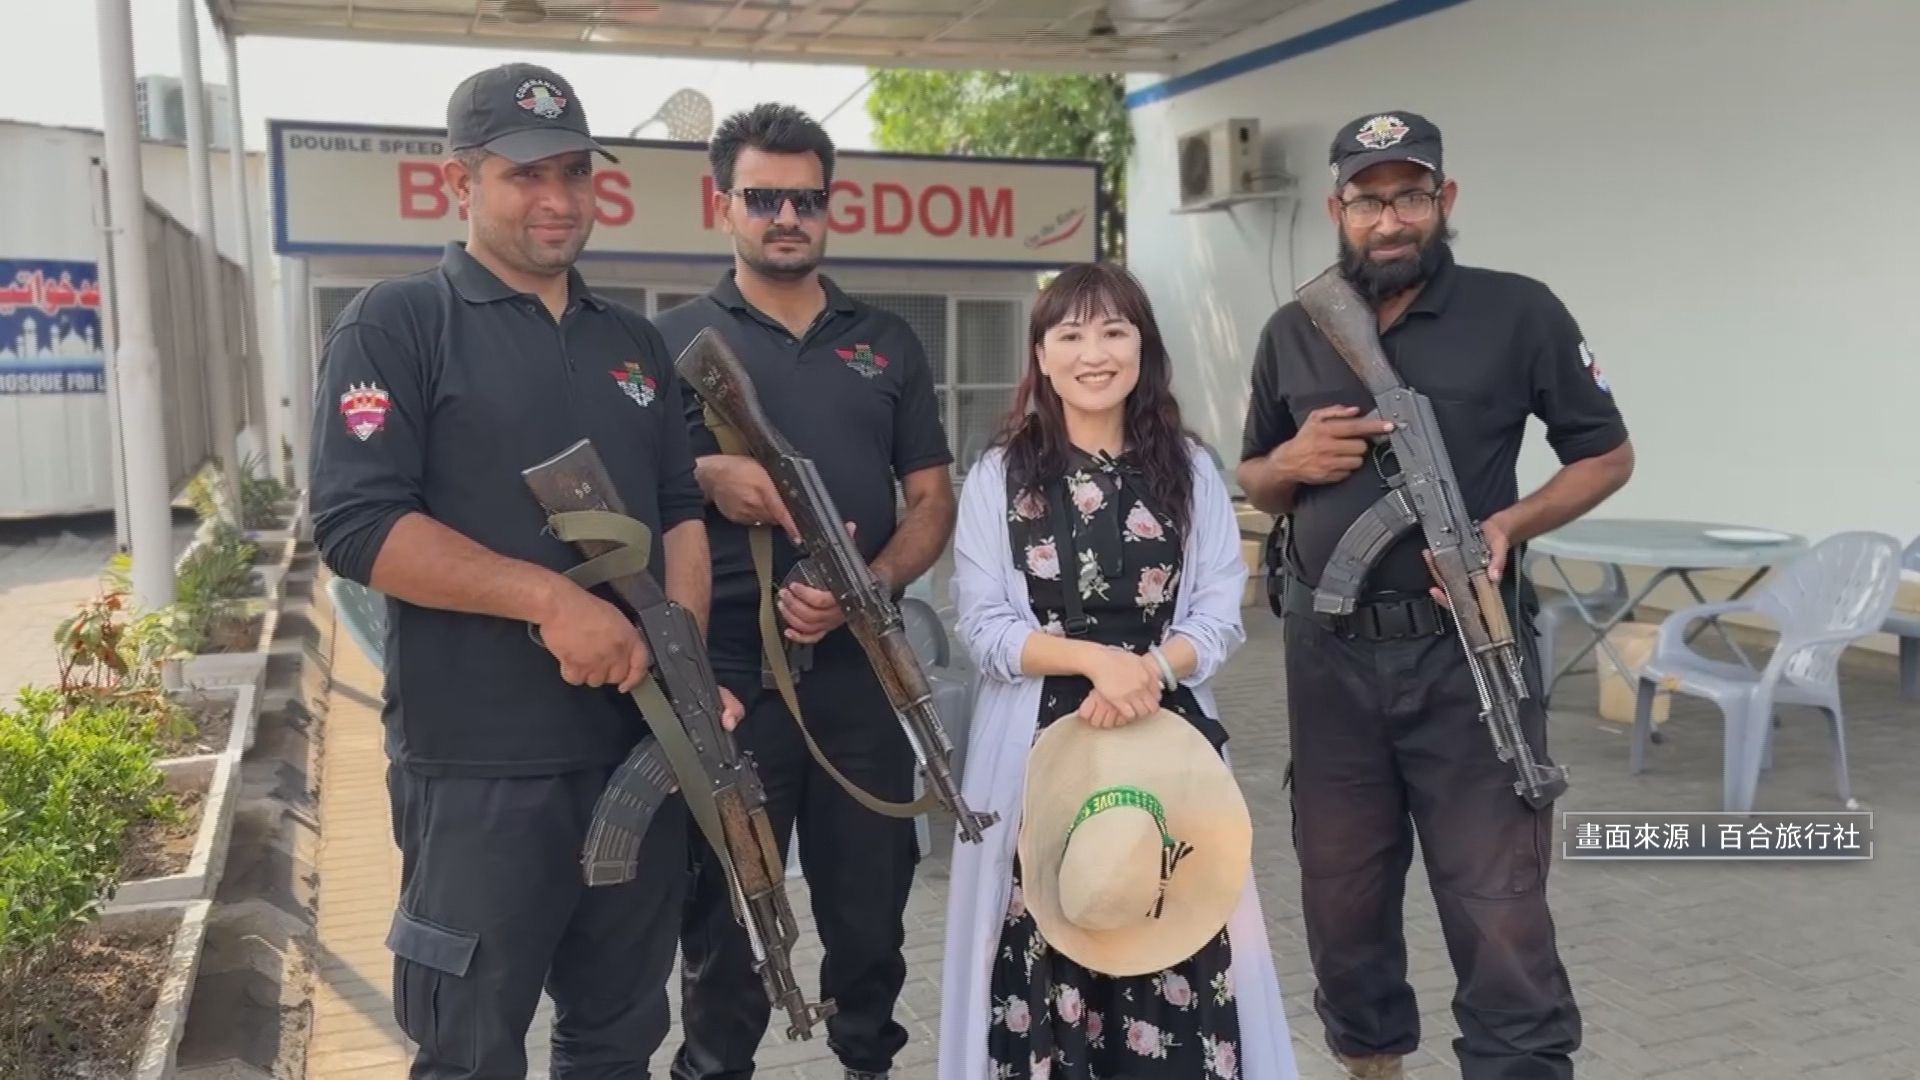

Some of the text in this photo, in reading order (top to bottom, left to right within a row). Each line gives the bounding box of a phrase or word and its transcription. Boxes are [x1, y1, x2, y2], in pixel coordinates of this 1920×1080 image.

[289, 134, 443, 155] DOUBLE SPEED
[67, 373, 94, 391] FOR
